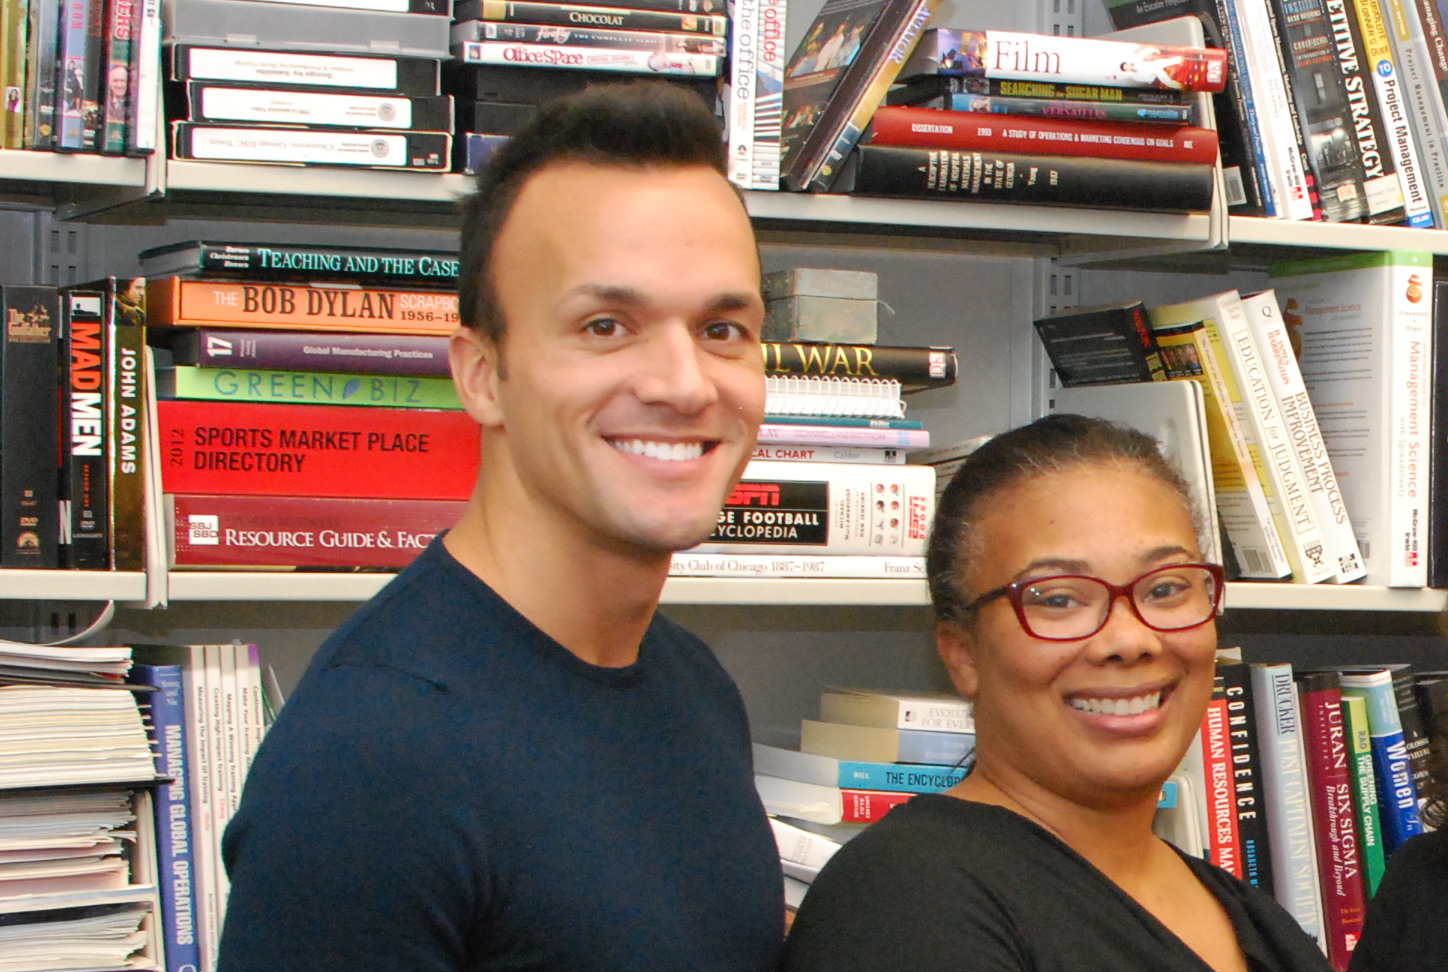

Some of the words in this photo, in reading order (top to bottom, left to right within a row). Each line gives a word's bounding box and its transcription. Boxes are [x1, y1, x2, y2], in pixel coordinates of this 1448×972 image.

[569, 11, 624, 26] CHOCOLAT
[763, 8, 776, 62] office
[738, 29, 750, 99] office
[993, 40, 1062, 75] Film
[1381, 78, 1405, 123] Project
[912, 123, 953, 135] DISSERTATION
[977, 127, 992, 137] 1993
[1344, 75, 1384, 180] STRATEGY
[1391, 124, 1425, 203] Management
[258, 248, 342, 272] TEACHING
[345, 251, 377, 273] AND
[381, 253, 414, 275] THE
[418, 255, 460, 276] CASE
[213, 290, 238, 306] THE
[243, 286, 295, 314] BOB
[307, 290, 394, 319] DYLAN
[1130, 308, 1152, 348] WALTON
[71, 322, 101, 391] MAD
[303, 345, 331, 356] Global
[332, 346, 393, 359] Manufacturing
[395, 348, 433, 360] Practices
[793, 344, 878, 376] WAR
[121, 348, 136, 398] JOHN
[213, 371, 333, 398] GREEN
[370, 377, 421, 403] BIZ
[1234, 336, 1275, 422] EDUCATION
[1406, 340, 1420, 436] Management
[71, 392, 102, 456] MEN
[121, 405, 136, 474] ADAMS
[194, 426, 273, 448] SPORTS
[280, 429, 361, 450] MARKET
[367, 431, 429, 452] PLACE
[1264, 423, 1282, 442] for
[170, 428, 184, 466] 2012
[193, 451, 306, 472] DIRECTORY
[776, 449, 815, 460] CHART
[1277, 395, 1326, 496] IMPROVEMENT
[1292, 390, 1327, 460] BUSINESS
[1315, 460, 1349, 525] PROCESS
[1270, 442, 1312, 528] JUDGMENT
[1407, 441, 1418, 498] Science
[744, 512, 819, 525] FOOTBALL
[909, 496, 919, 539] ESPN
[225, 529, 314, 546] RESOURCE
[319, 530, 375, 548] GUIDE
[377, 533, 393, 548] &
[688, 560, 712, 572] Club
[715, 561, 725, 572] of
[727, 561, 768, 575] Chicago
[196, 686, 205, 724] Measuring
[212, 687, 221, 717] Creating
[1273, 673, 1295, 735] DRUCKER
[198, 725, 206, 738] The
[199, 739, 207, 763] Impact
[213, 718, 223, 761] High-Impact
[1206, 706, 1225, 758] HUMAN
[1324, 700, 1346, 769] JURAN
[1357, 730, 1367, 749] RAO
[164, 724, 183, 801] MANAGING
[200, 764, 207, 773] Of
[1225, 686, 1256, 821] CONFIDENCE
[1357, 755, 1366, 775] THE
[200, 774, 209, 804] Training
[215, 762, 224, 791] Training
[1365, 754, 1376, 805] GREENING
[1385, 741, 1415, 809] Women
[1211, 761, 1233, 844] RESOURCES
[1325, 784, 1340, 842] Breakthrough
[1336, 782, 1351, 814] SIX
[1359, 776, 1370, 814] SUPPLY
[169, 804, 187, 857] GLOBAL
[1339, 817, 1357, 879] SIGMA
[1363, 815, 1374, 846] CHAIN
[1331, 844, 1341, 862] and
[1332, 863, 1345, 896] Beyond
[172, 860, 192, 945] OPERATIONS
